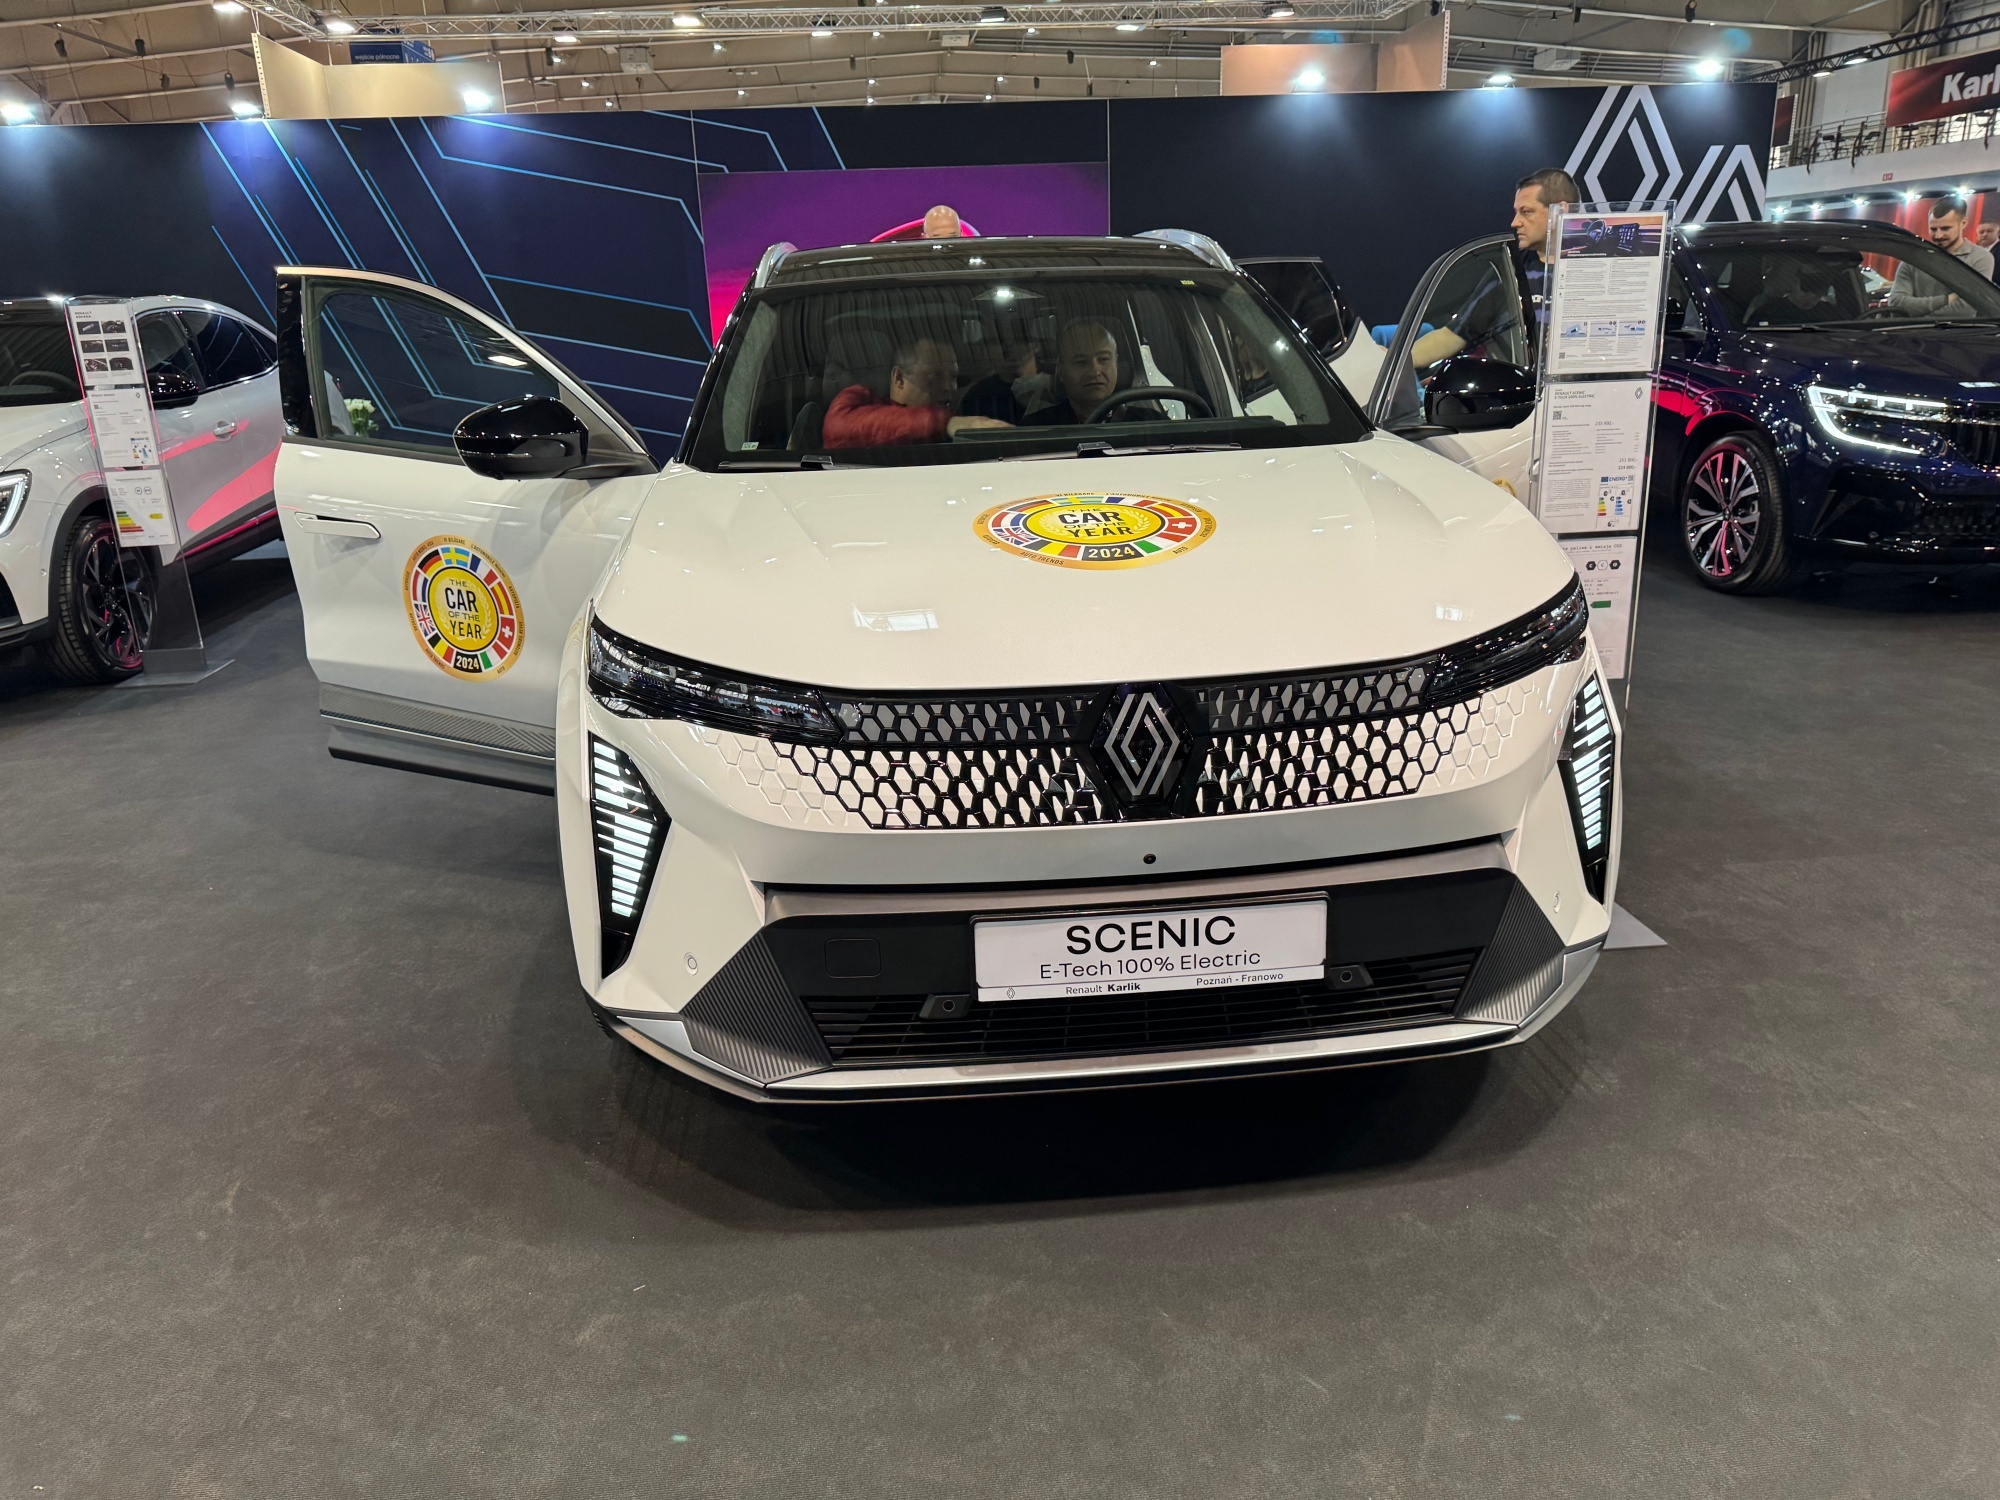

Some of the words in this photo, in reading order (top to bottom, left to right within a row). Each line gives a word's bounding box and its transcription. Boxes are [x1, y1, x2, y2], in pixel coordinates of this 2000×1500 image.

[1058, 512, 1126, 525] CAR
[1066, 526, 1135, 538] YEAR
[1088, 546, 1135, 559] 2024
[1172, 546, 1188, 555] AUTO
[1020, 551, 1036, 559] AUTO
[1038, 556, 1065, 565] TRENDS
[449, 578, 468, 587] THE
[445, 587, 478, 613] CAR
[448, 611, 460, 619] OF
[462, 613, 481, 621] THE
[449, 620, 483, 639] YEAR
[456, 656, 479, 670] 2024
[1066, 915, 1236, 955] SCENIC
[1040, 962, 1113, 979] E-Tech
[1117, 956, 1175, 976] 100%
[1180, 950, 1262, 971] Electric
[1066, 985, 1103, 995] Renault
[1107, 981, 1141, 992] Karlik
[1196, 975, 1233, 987] Poznań
[1241, 973, 1284, 983] Franowo
